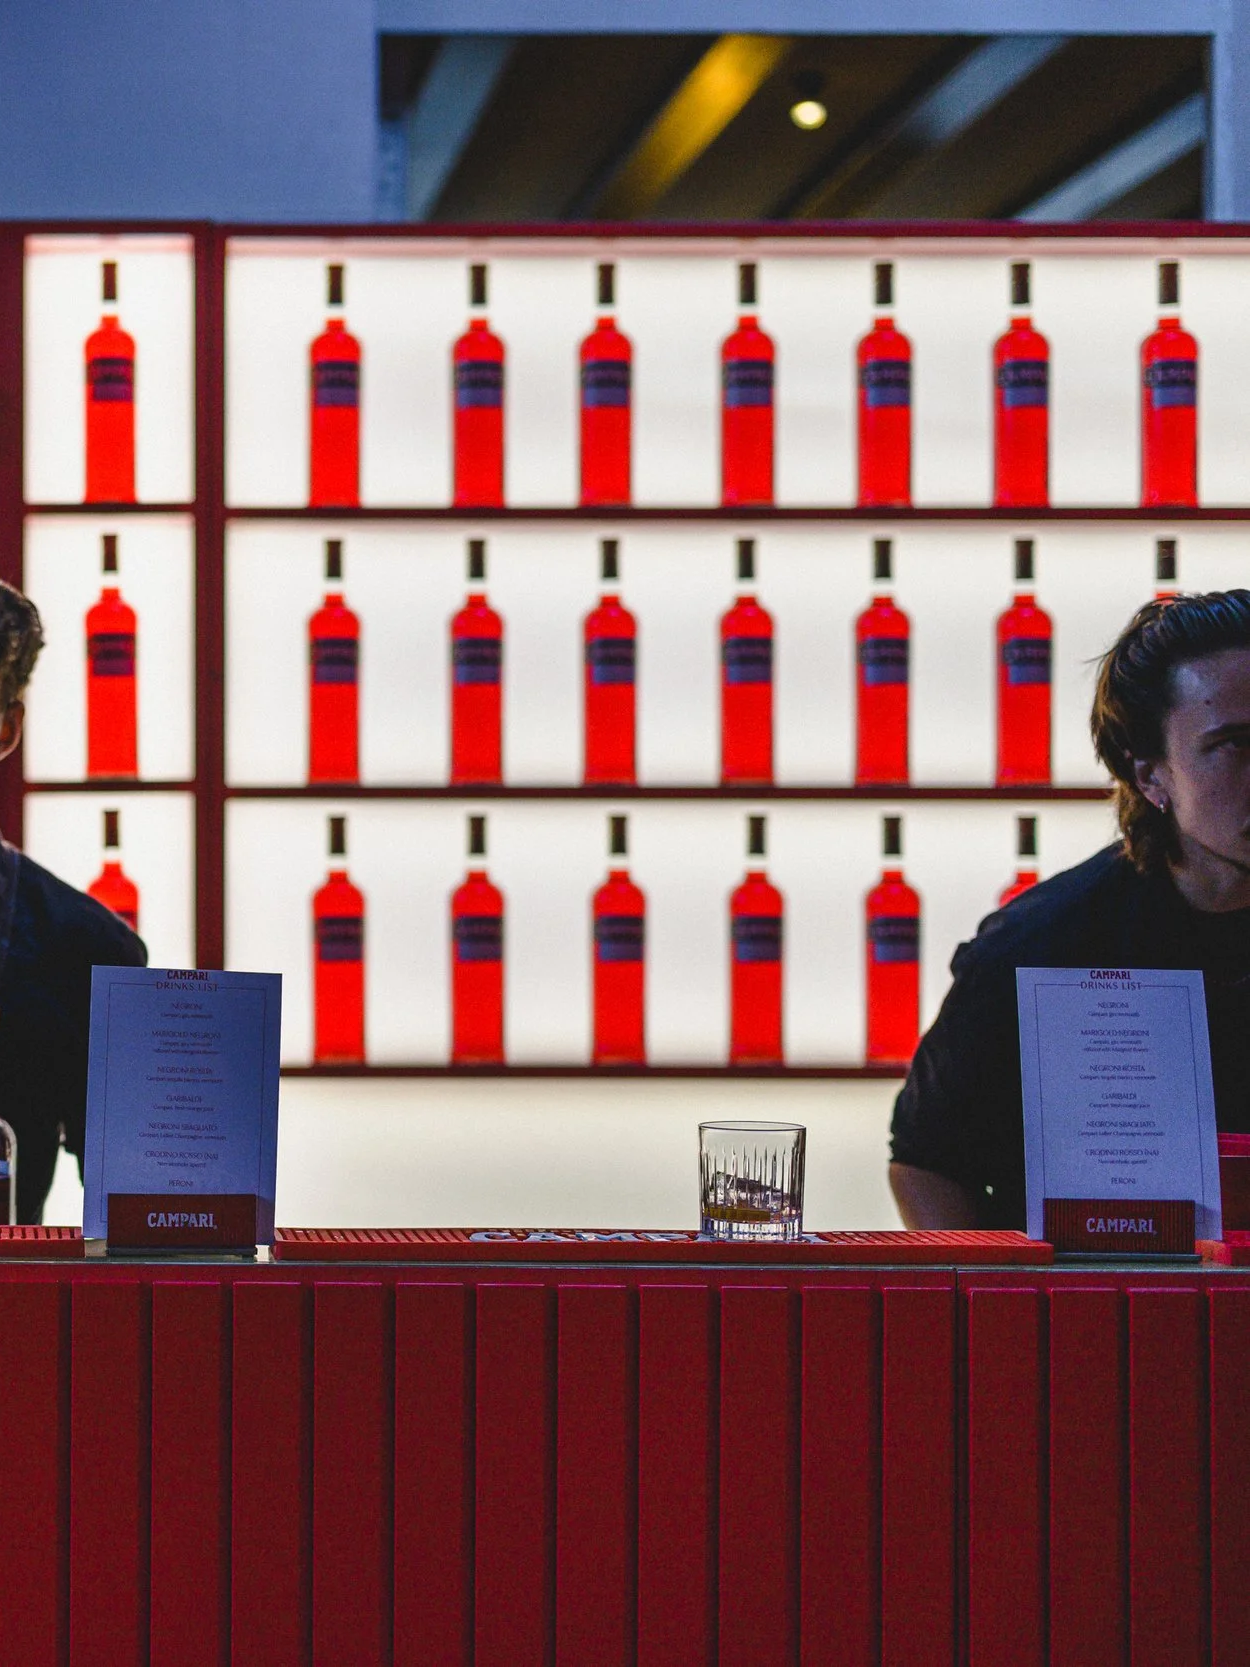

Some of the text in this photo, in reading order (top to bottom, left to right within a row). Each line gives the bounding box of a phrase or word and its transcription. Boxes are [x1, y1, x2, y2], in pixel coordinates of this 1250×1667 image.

[167, 970, 209, 980] CAMPARI
[1090, 970, 1131, 979] CAMPARI
[156, 981, 219, 991] DRINKS LIST
[1080, 981, 1142, 990] DRINKS LIST
[145, 1150, 178, 1158] CRODINO
[168, 1179, 194, 1187] PERONI
[147, 1212, 214, 1228] CAMPARI
[1086, 1217, 1154, 1233] CAMPARI
